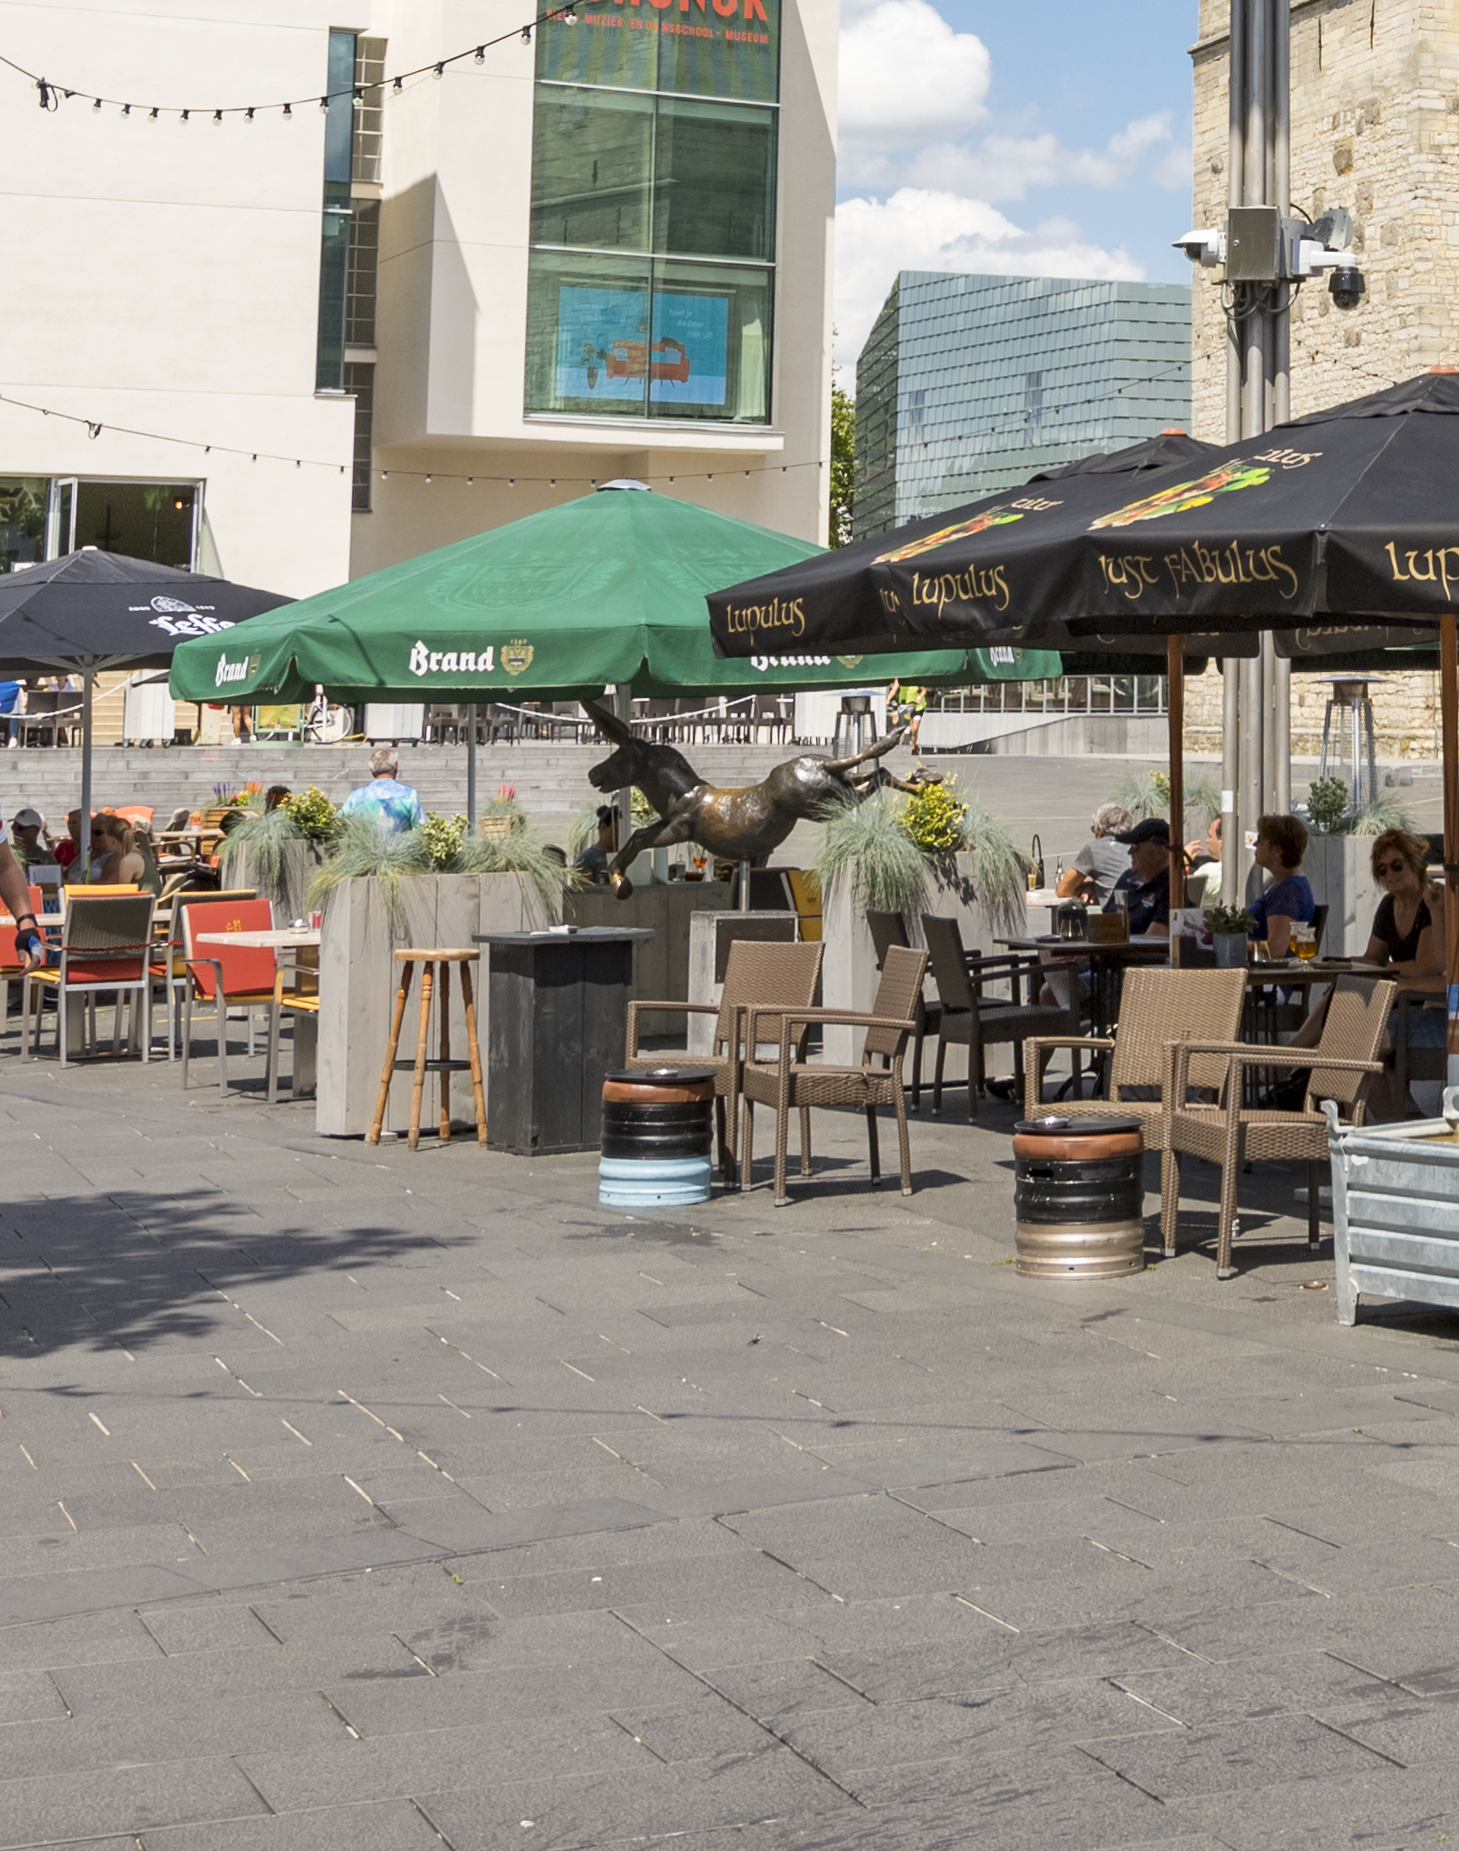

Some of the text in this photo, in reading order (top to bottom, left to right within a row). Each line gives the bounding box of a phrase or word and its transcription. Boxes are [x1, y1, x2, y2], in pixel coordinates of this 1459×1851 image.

[725, 30, 768, 44] MUSEUM
[148, 613, 236, 637] Leffe
[215, 652, 250, 688] Brand
[408, 639, 495, 677] Brand
